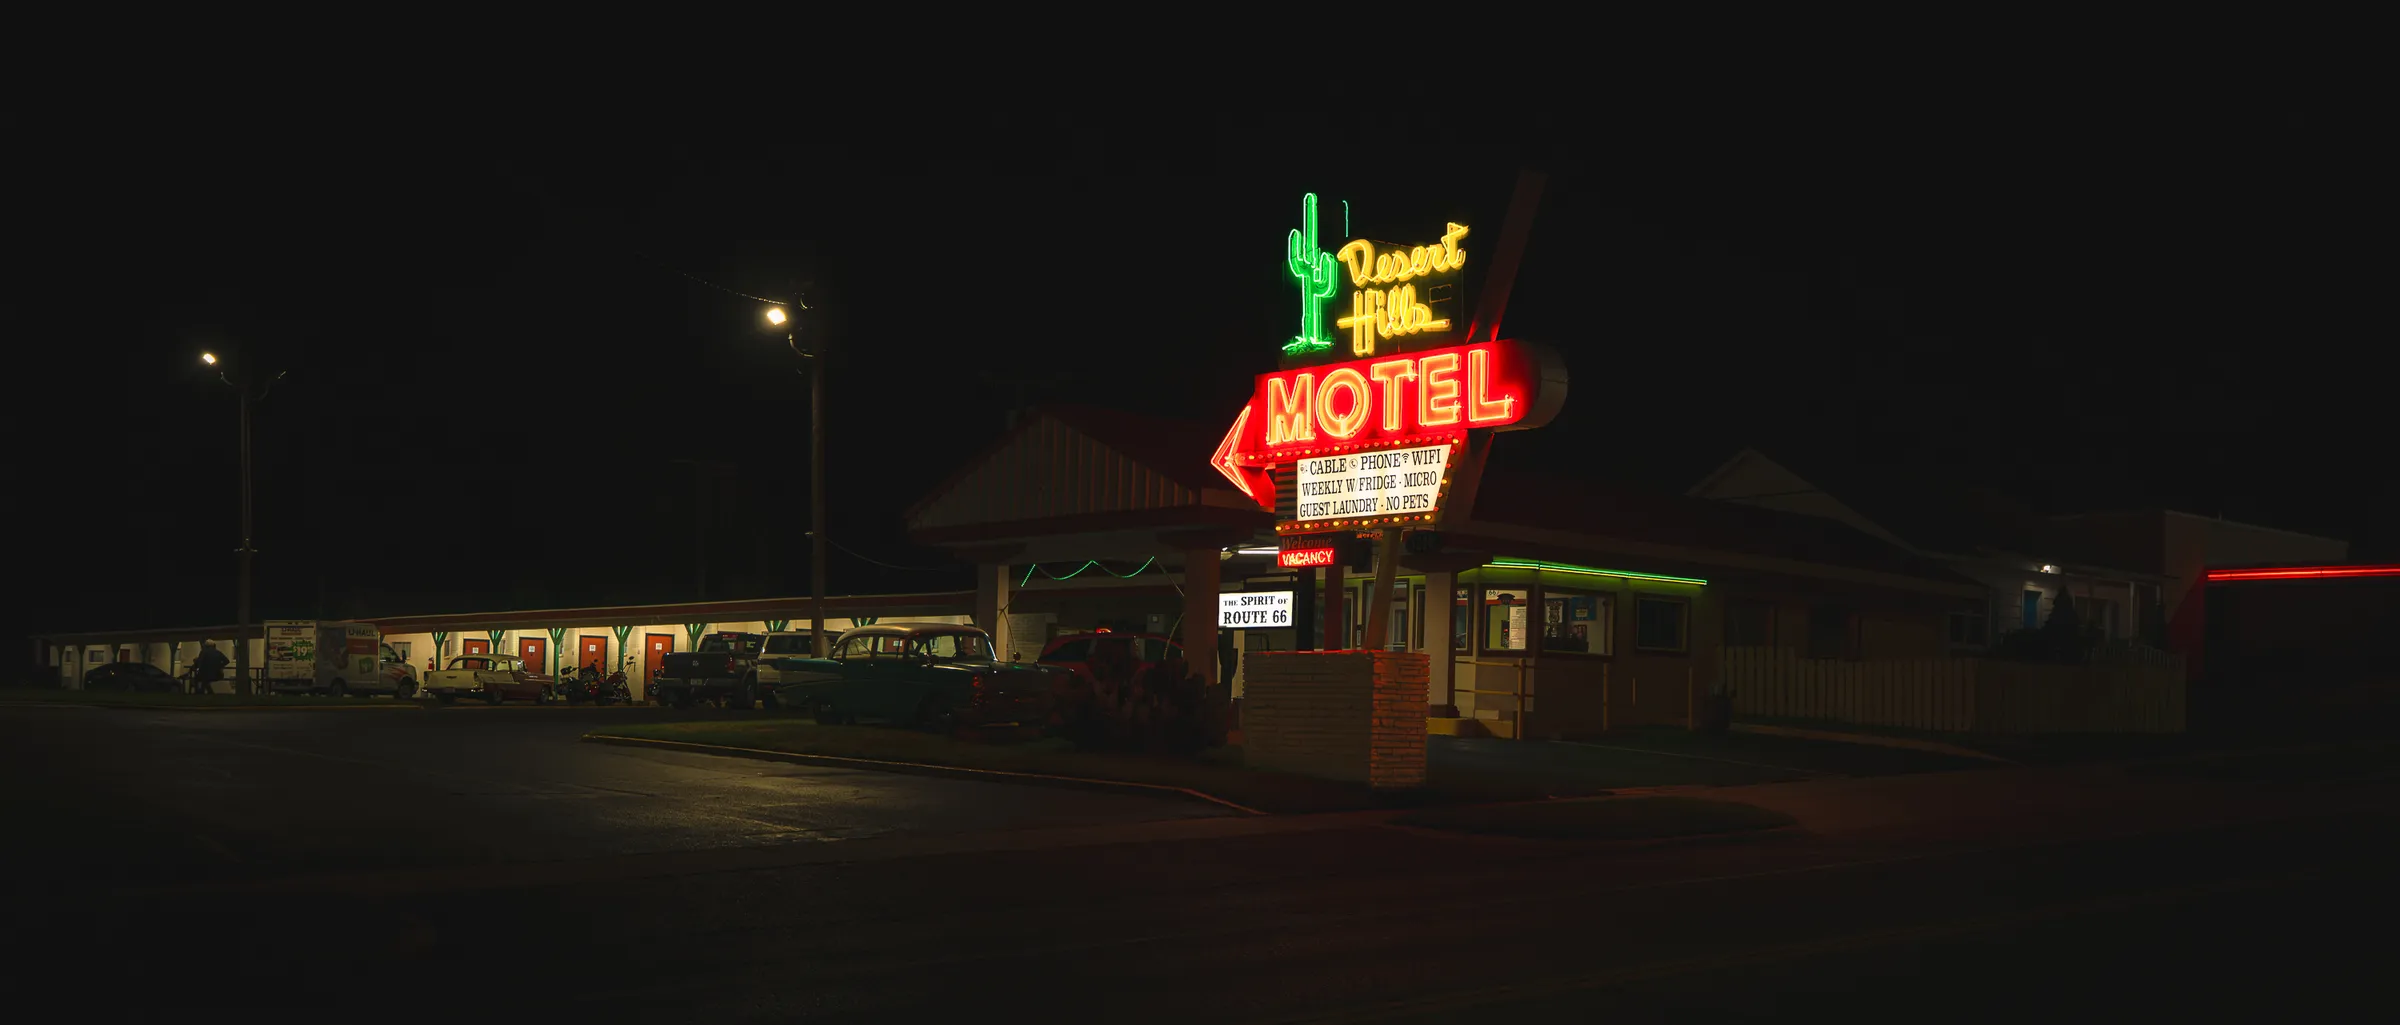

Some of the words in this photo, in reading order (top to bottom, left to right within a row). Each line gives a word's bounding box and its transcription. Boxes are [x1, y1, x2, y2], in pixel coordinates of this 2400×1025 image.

[1337, 222, 1469, 288] Desert
[1337, 282, 1452, 357] Hills
[1266, 349, 1515, 445] MOTEL
[1310, 458, 1347, 475] CABLE
[1360, 452, 1401, 471] PHONE
[1411, 448, 1441, 466] WIFI
[1301, 479, 1343, 497] WEEKLY
[1403, 470, 1437, 488] MICRO
[1299, 501, 1331, 518] GUEST
[1332, 497, 1379, 515] LAUNDRY
[1386, 495, 1400, 511] NO
[1402, 493, 1429, 510] PETS
[1282, 550, 1333, 566] VACANCY
[1241, 596, 1275, 607] SPIRIT
[1223, 611, 1267, 625] ROUTE
[1272, 609, 1287, 624] 66
